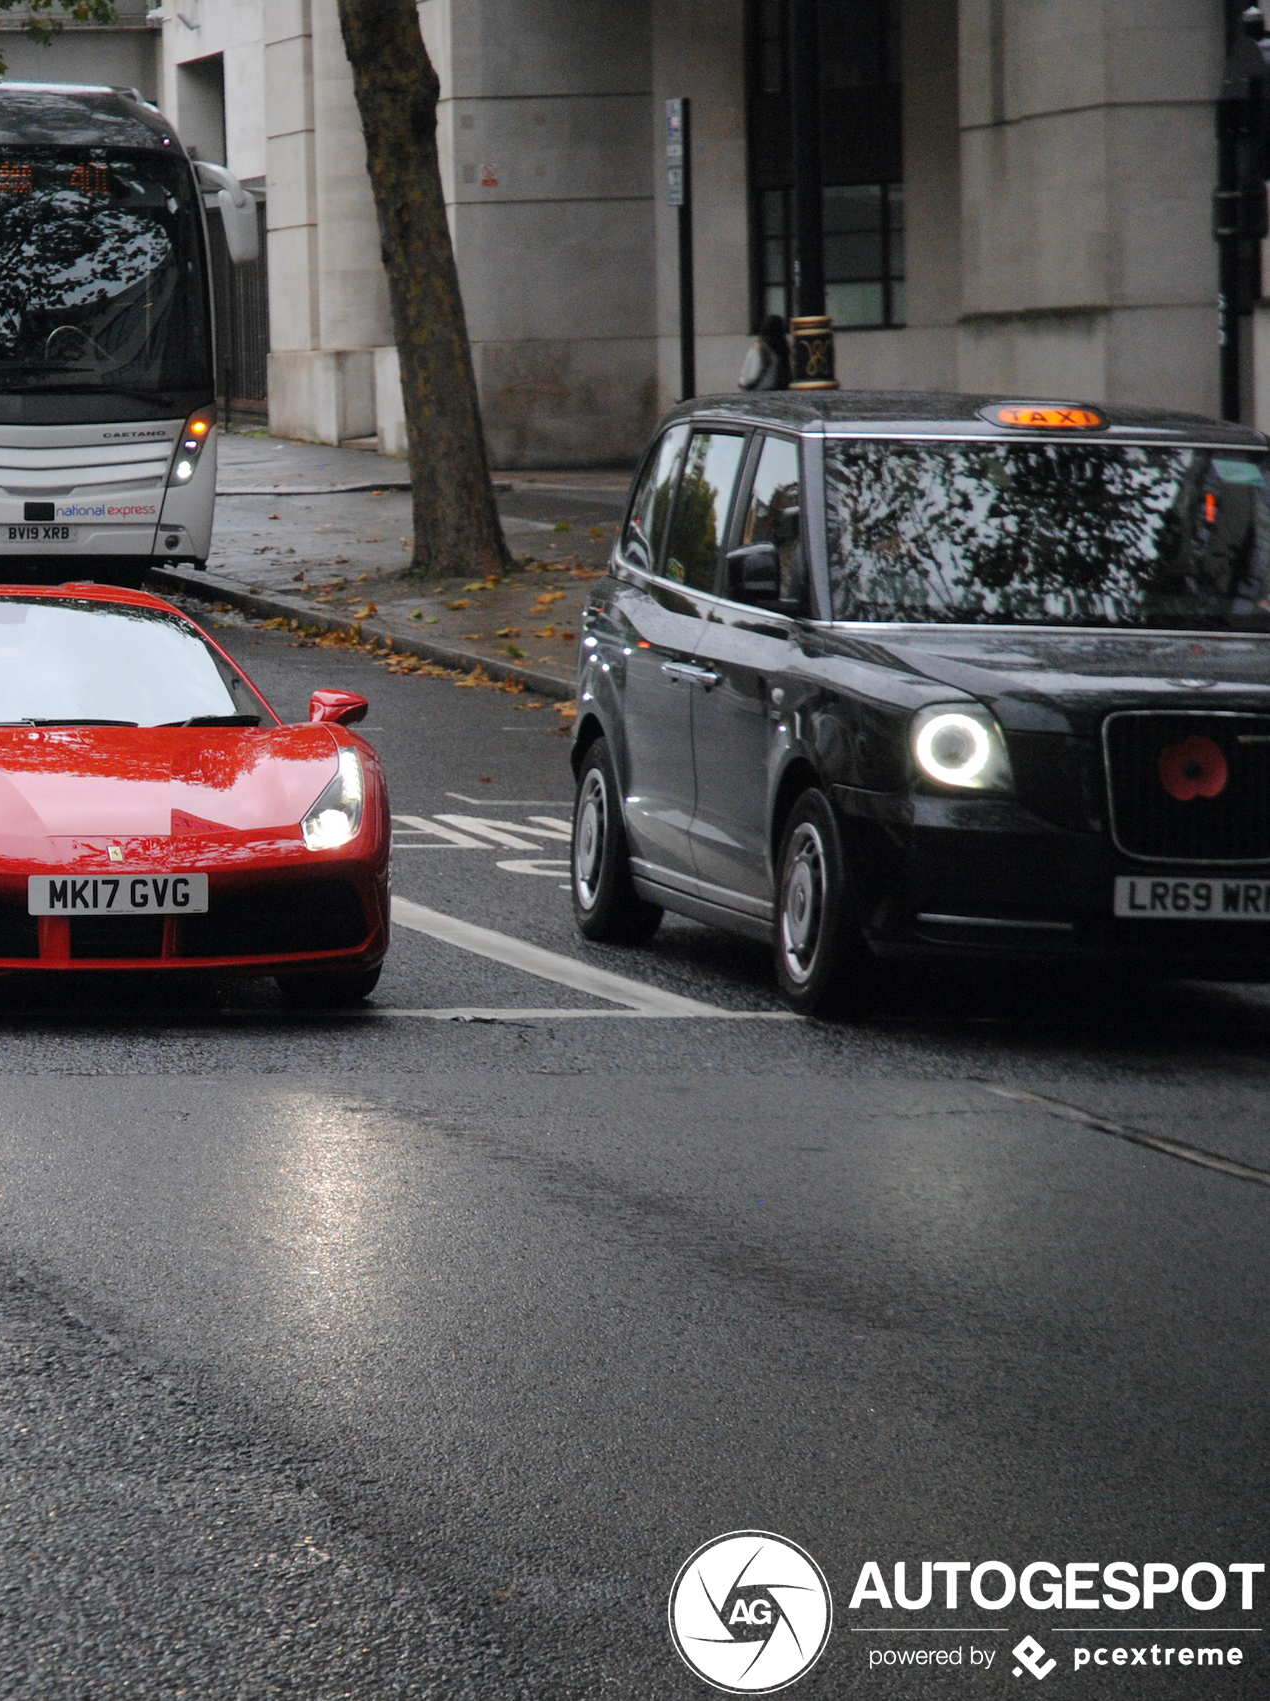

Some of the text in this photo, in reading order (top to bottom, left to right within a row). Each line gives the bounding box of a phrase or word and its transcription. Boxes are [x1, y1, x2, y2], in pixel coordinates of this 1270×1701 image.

[1007, 409, 1092, 424] TAXI
[103, 430, 166, 439] CAETANO
[56, 504, 156, 518] national express
[8, 527, 70, 540] BV19 XRB
[49, 878, 190, 909] MK17 GVG
[1129, 881, 1212, 912] LR69
